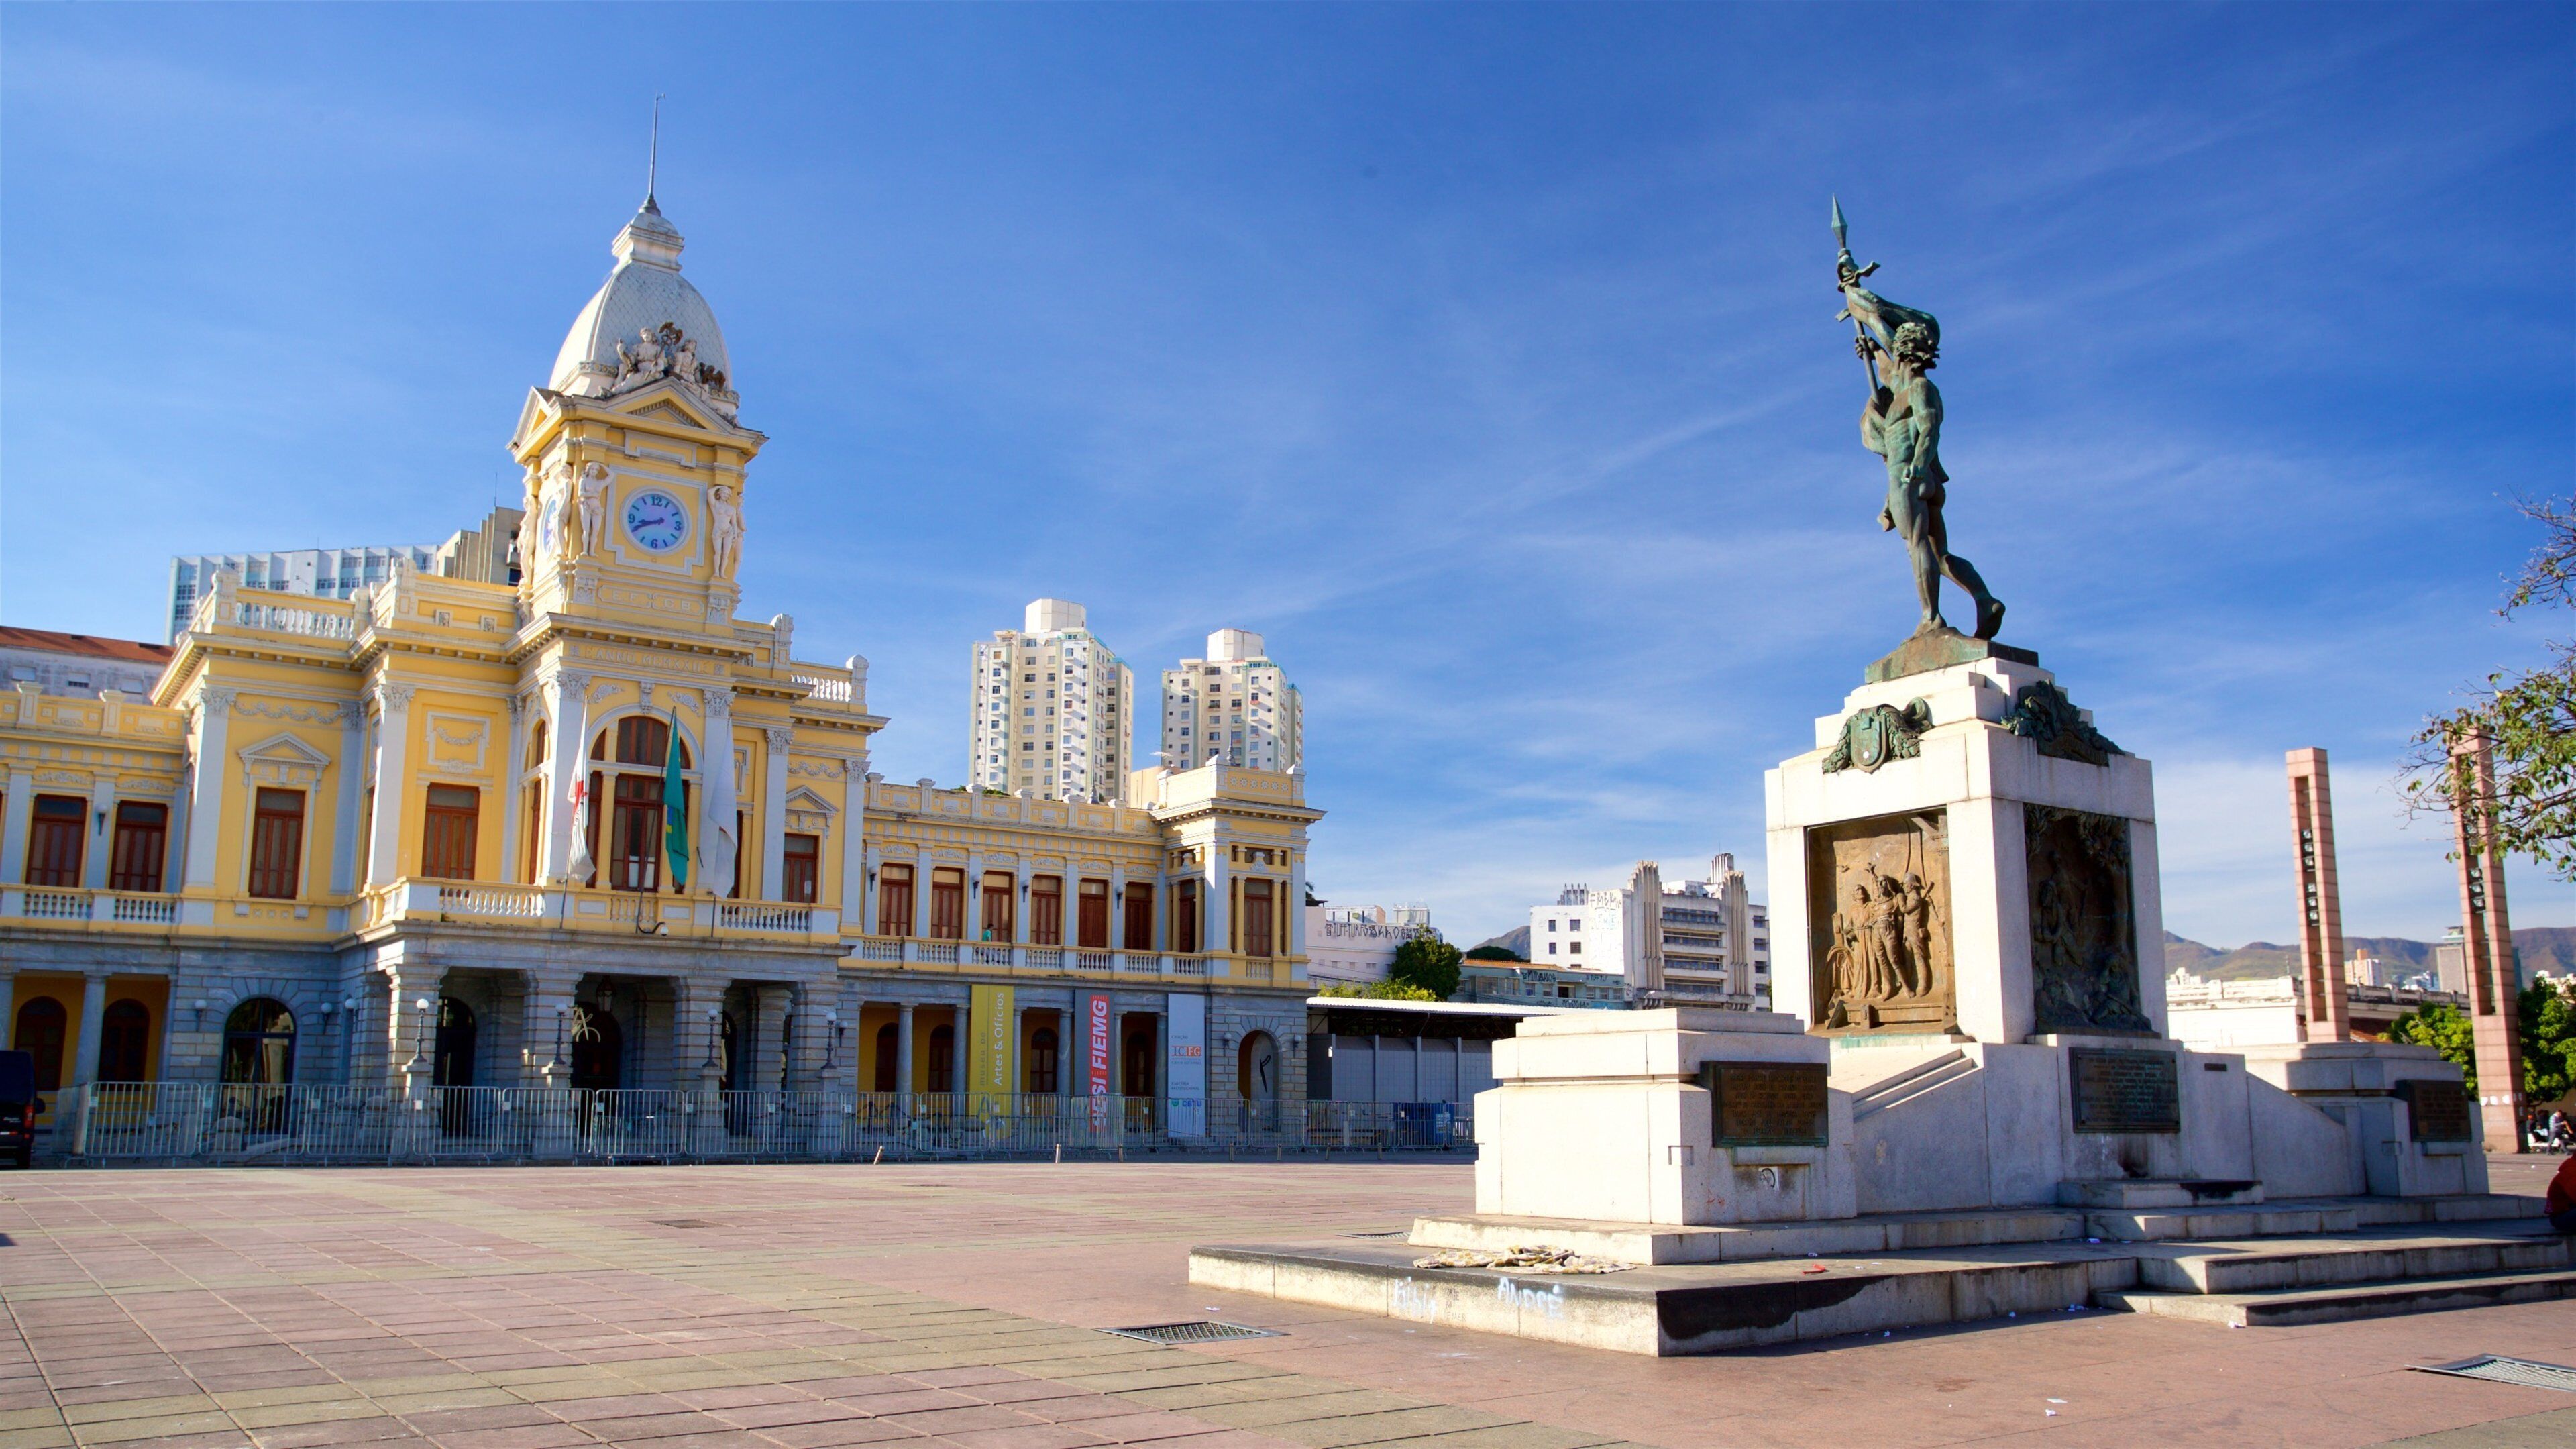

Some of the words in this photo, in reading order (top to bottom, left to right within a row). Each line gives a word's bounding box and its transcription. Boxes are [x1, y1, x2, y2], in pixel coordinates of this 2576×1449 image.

[651, 496, 663, 507] 12
[628, 514, 636, 523] 9
[674, 521, 682, 531] 3
[651, 539, 659, 549] 6
[994, 992, 1004, 1038] Ofícios
[1092, 1000, 1107, 1071] FIEMG
[994, 1040, 1003, 1051] &
[994, 1053, 1003, 1085] Artes
